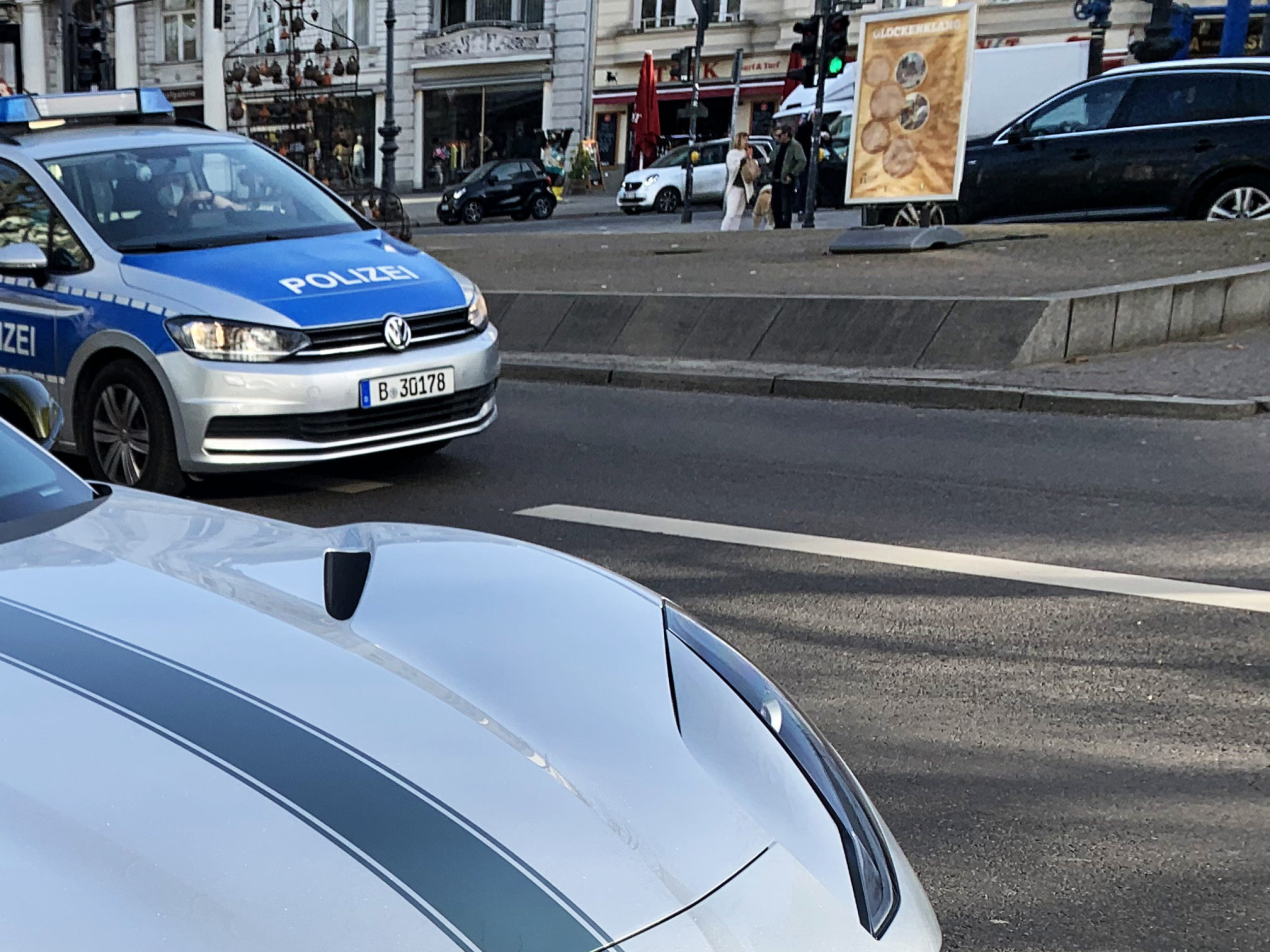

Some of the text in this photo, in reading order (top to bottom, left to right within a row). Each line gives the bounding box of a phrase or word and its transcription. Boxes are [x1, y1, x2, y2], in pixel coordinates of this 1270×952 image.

[872, 19, 961, 39] GLOCKENKLANG
[278, 265, 420, 294] POLIZEI
[378, 372, 446, 401] B 30178
